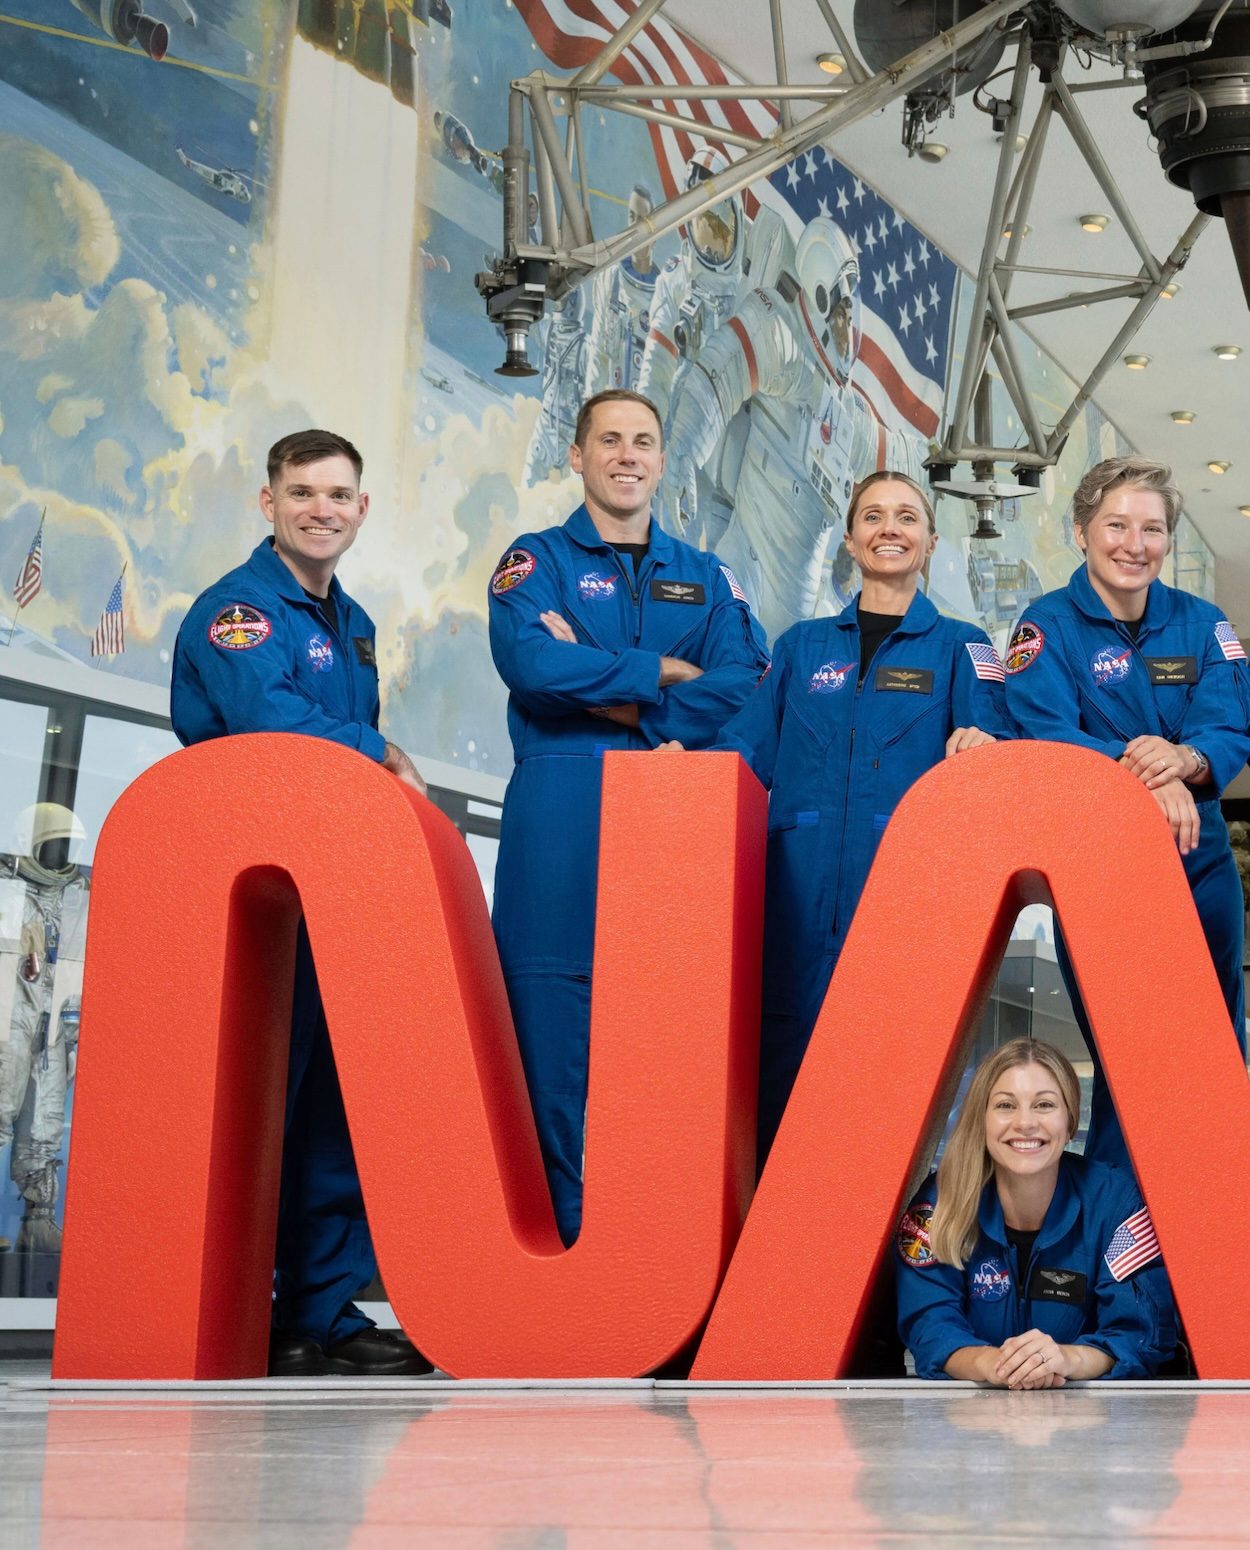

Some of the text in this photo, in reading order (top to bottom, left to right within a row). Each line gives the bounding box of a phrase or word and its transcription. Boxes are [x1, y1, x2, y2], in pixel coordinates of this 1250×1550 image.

[579, 580, 616, 592] NASA
[309, 646, 333, 660] NASA
[1093, 658, 1130, 673] NASA
[812, 670, 845, 682] NASA
[973, 1272, 1011, 1287] NASA
